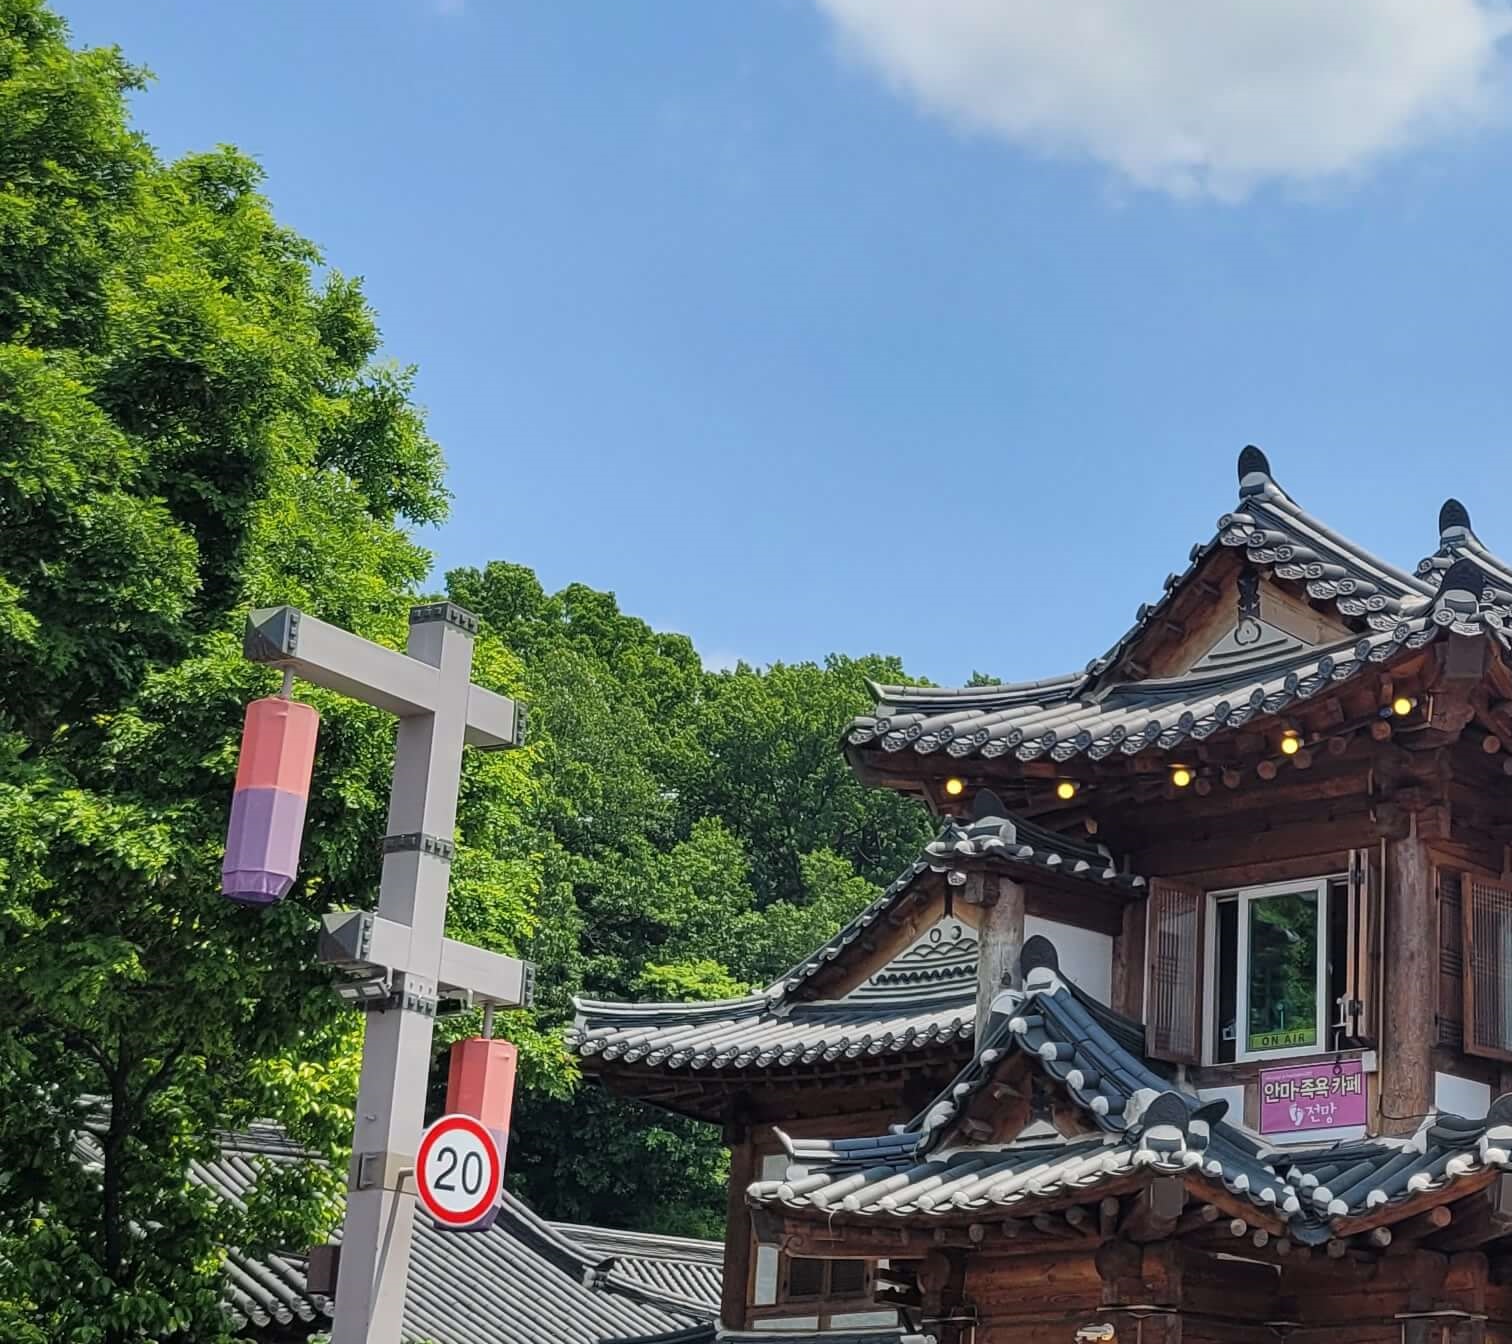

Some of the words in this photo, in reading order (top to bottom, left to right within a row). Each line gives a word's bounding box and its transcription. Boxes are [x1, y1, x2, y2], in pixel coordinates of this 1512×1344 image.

[1261, 1035, 1279, 1047] ON
[1283, 1033, 1306, 1045] AIR
[1304, 1102, 1337, 1125] 전망
[433, 1146, 483, 1195] 20
